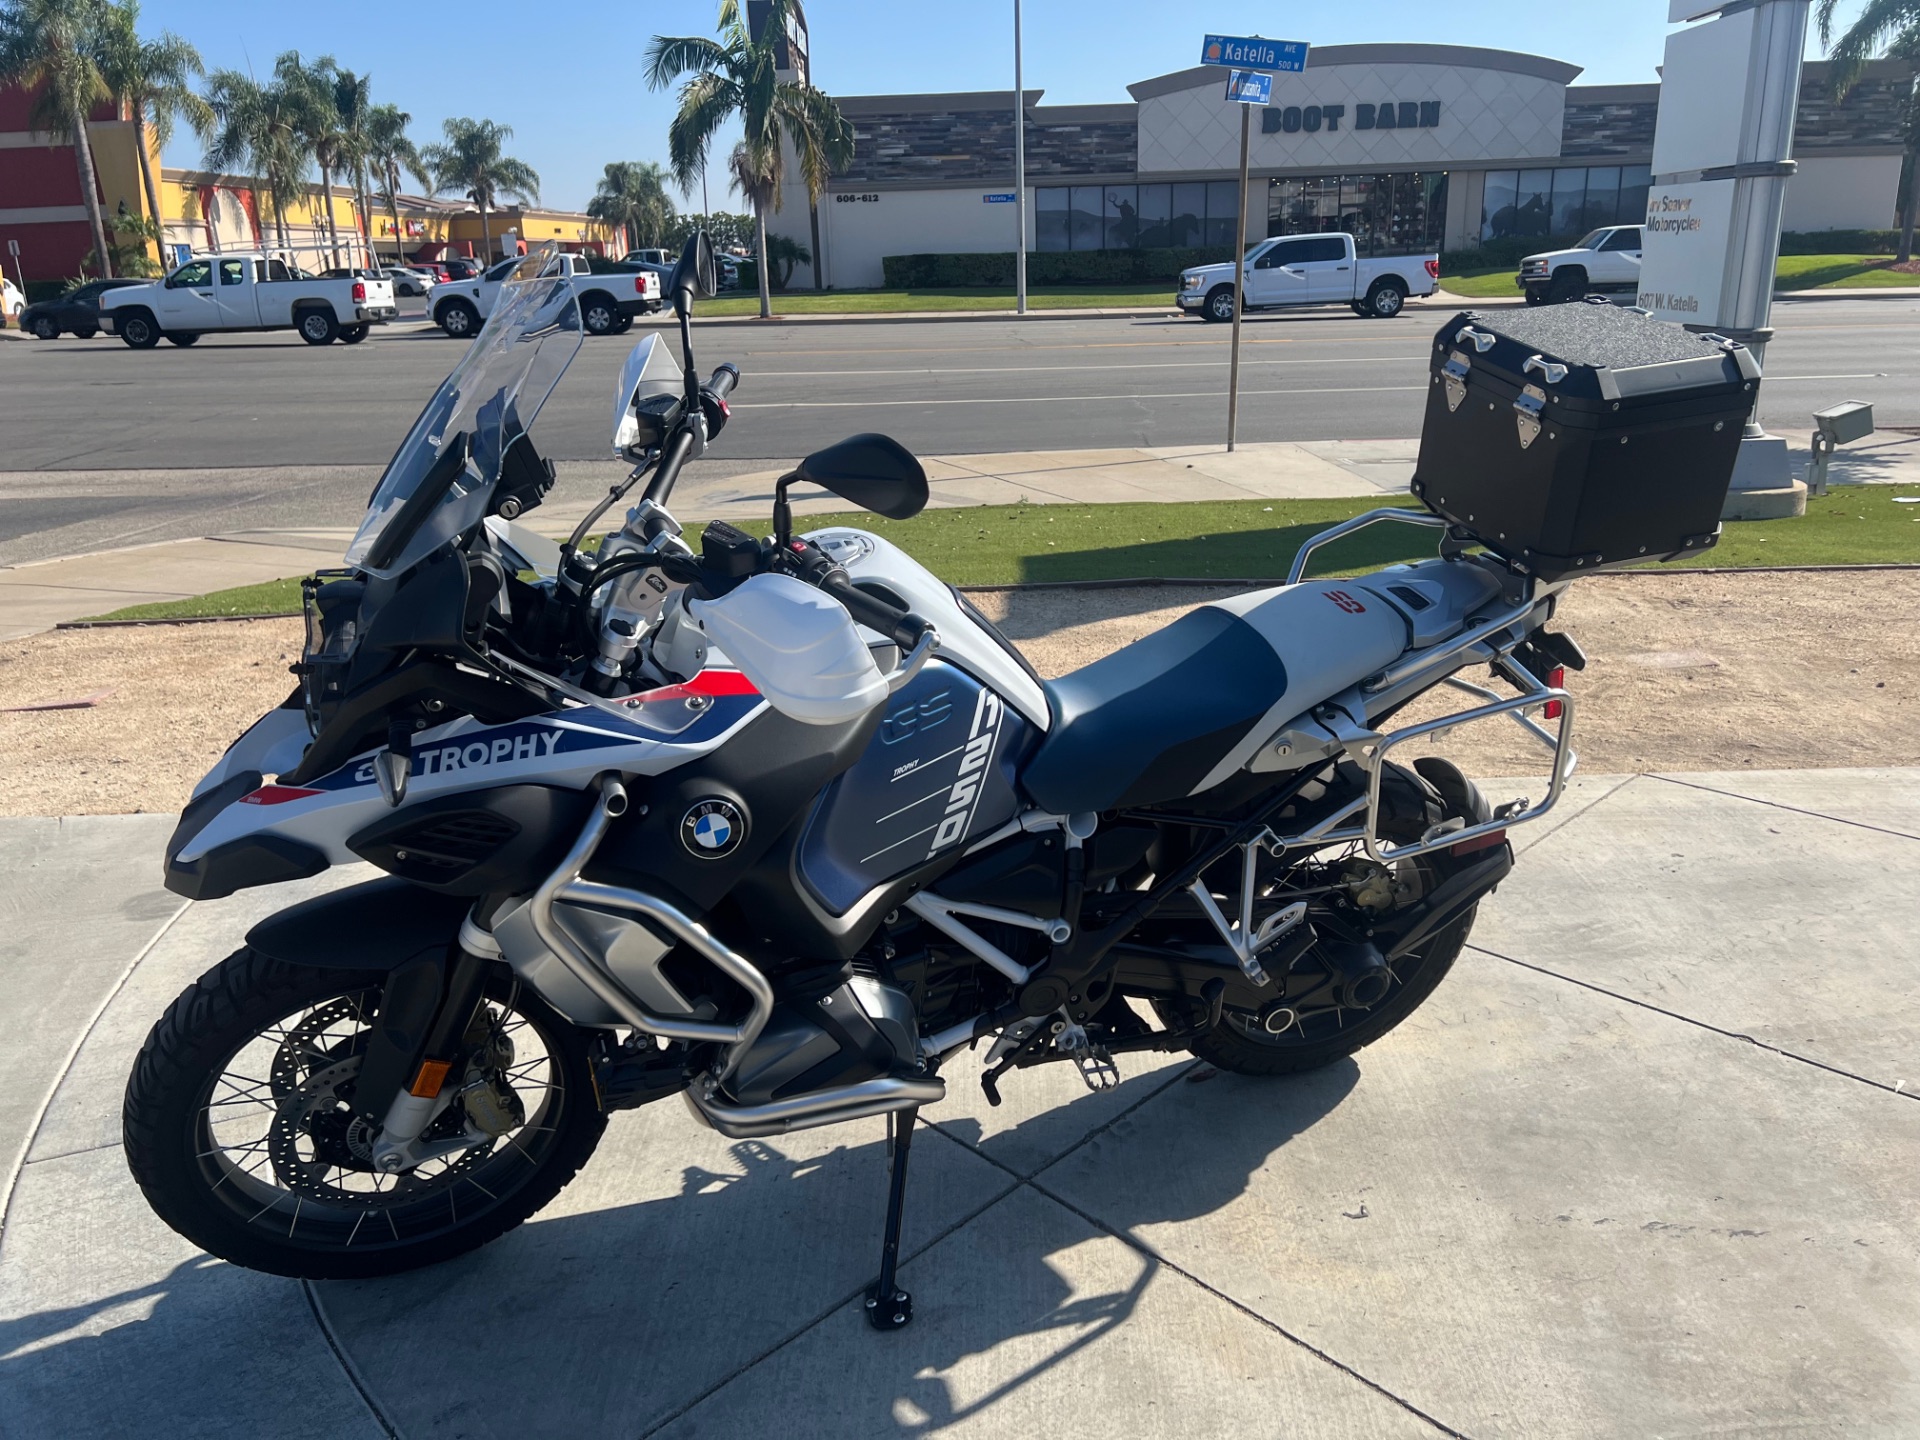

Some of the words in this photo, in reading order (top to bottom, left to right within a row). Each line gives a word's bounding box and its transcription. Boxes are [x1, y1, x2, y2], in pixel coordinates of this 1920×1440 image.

[1224, 43, 1275, 64] Katella
[1284, 44, 1297, 54] AVE
[1278, 60, 1292, 70] 500
[1293, 62, 1300, 70] W
[1262, 105, 1345, 134] BOOT
[1355, 101, 1441, 130] BARN
[836, 194, 880, 203] 606-612
[1638, 292, 1654, 309] 607
[1655, 293, 1665, 310] W.
[1667, 294, 1699, 313] Katella
[418, 730, 565, 777] TROPHY
[893, 758, 920, 777] TROPHY
[685, 803, 733, 828] BMW
